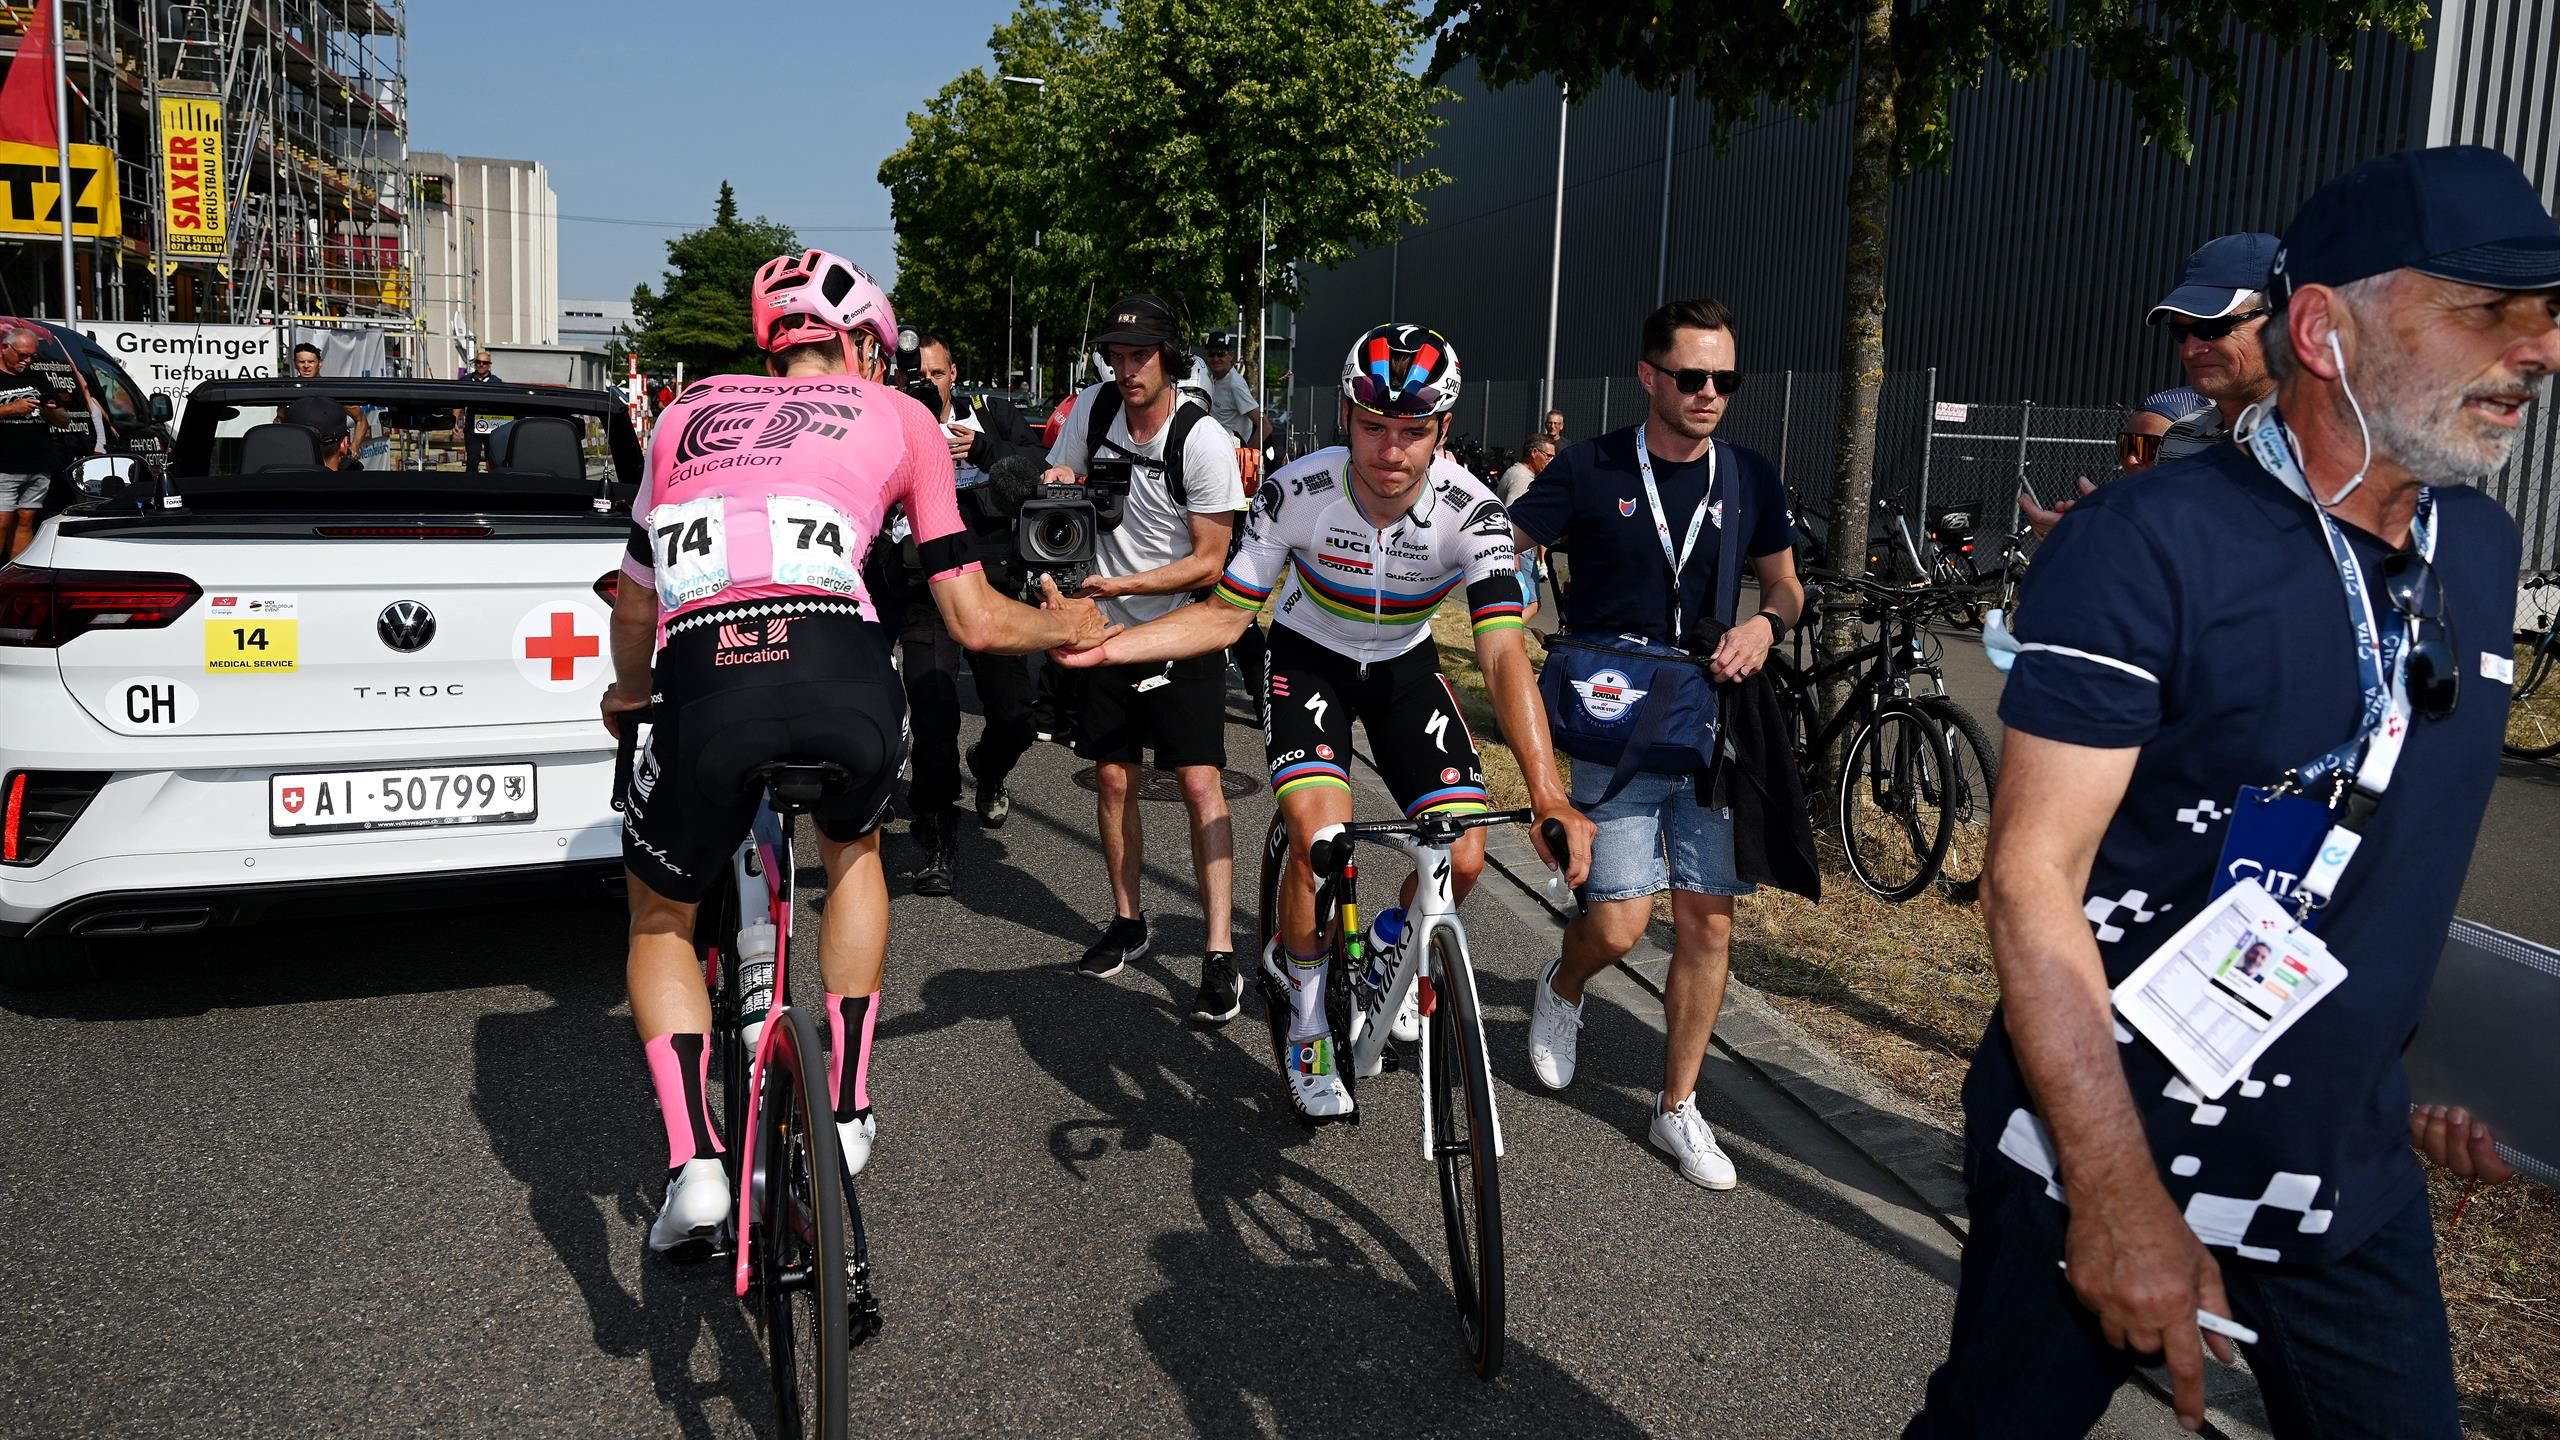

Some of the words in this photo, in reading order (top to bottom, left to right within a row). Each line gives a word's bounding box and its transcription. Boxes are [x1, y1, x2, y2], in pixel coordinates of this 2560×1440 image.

[203, 137, 215, 156] AG
[170, 135, 202, 230] SAXER
[203, 160, 219, 231] GERÜSTBAU
[193, 236, 223, 244] SULGEN
[851, 300, 873, 319] easypost
[116, 332, 269, 360] Greminger
[150, 364, 229, 381] Tiefbau
[238, 365, 269, 380] AG
[717, 383, 863, 398] easypost
[668, 453, 783, 488] Education
[1303, 470, 1330, 485] SAFETY
[1450, 485, 1475, 502] SAFETY
[657, 517, 713, 568] 74
[787, 517, 844, 558] 74
[1333, 539, 1371, 554] UCI
[1385, 546, 1430, 561] latexco
[1402, 542, 1429, 552] Ekopak
[1318, 558, 1374, 576] SOUDAL
[678, 577, 731, 601] energie
[806, 574, 853, 593] energie
[232, 628, 269, 651] 14
[209, 660, 252, 668] MEDICAL
[253, 660, 293, 668] SERVICE
[715, 647, 790, 666] Education
[354, 684, 464, 698] T-ROC
[1592, 690, 1621, 701] SOUDAL
[126, 684, 176, 724] CH
[377, 818, 438, 828] www.volkswagen.ch
